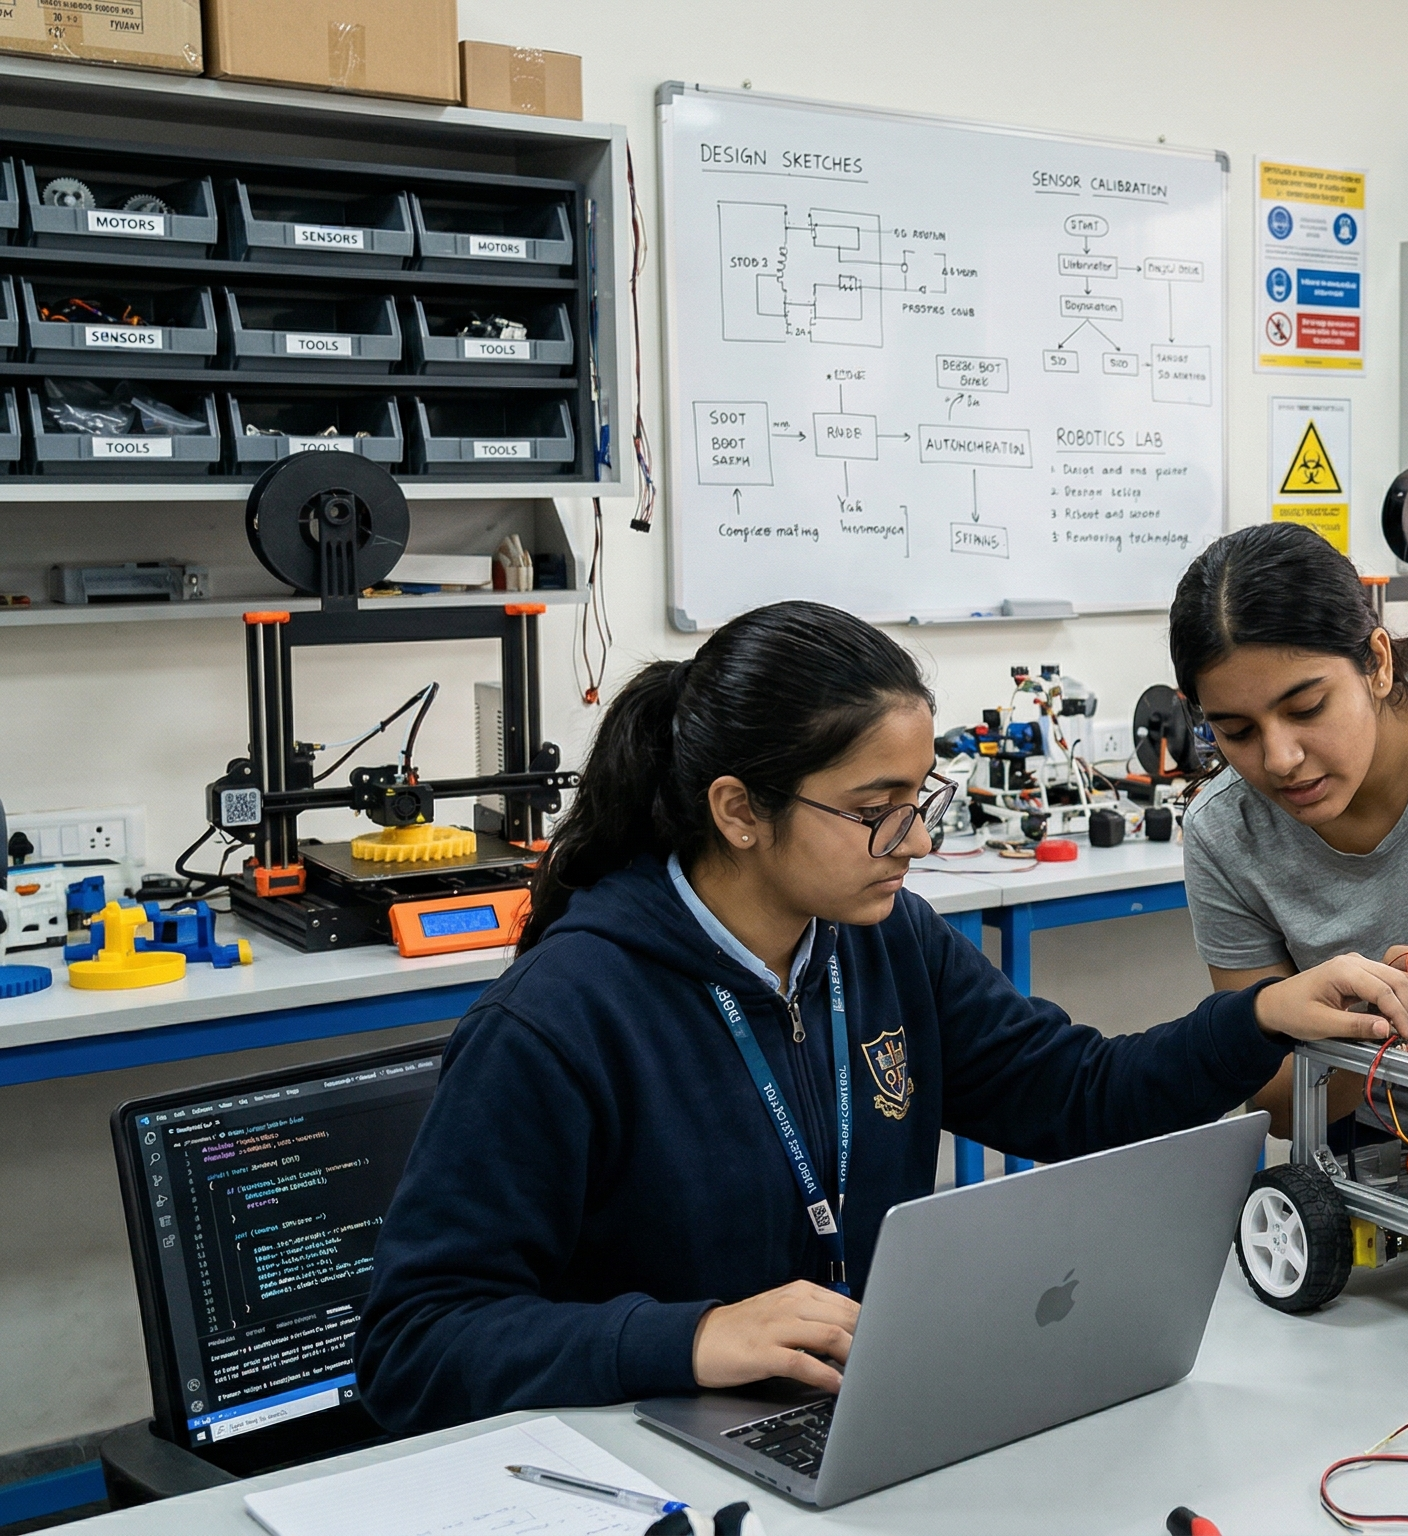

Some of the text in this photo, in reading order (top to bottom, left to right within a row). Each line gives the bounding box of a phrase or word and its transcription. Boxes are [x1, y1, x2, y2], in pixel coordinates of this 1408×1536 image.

[701, 143, 863, 173] DESIGN SKETCHES
[1032, 170, 1168, 197] SENSOR CALIBRATION
[97, 216, 155, 232] MOTORS
[301, 230, 358, 245] SENSORS
[478, 241, 520, 254] MOTORS
[299, 338, 339, 351] TOOLS
[480, 344, 515, 355] TOOLS
[711, 436, 746, 450] BOOT
[1056, 427, 1163, 448] ROBOTICS LAB
[105, 442, 150, 453] TOOLS
[300, 443, 339, 452] TOOLS
[481, 444, 517, 455] TOOLS
